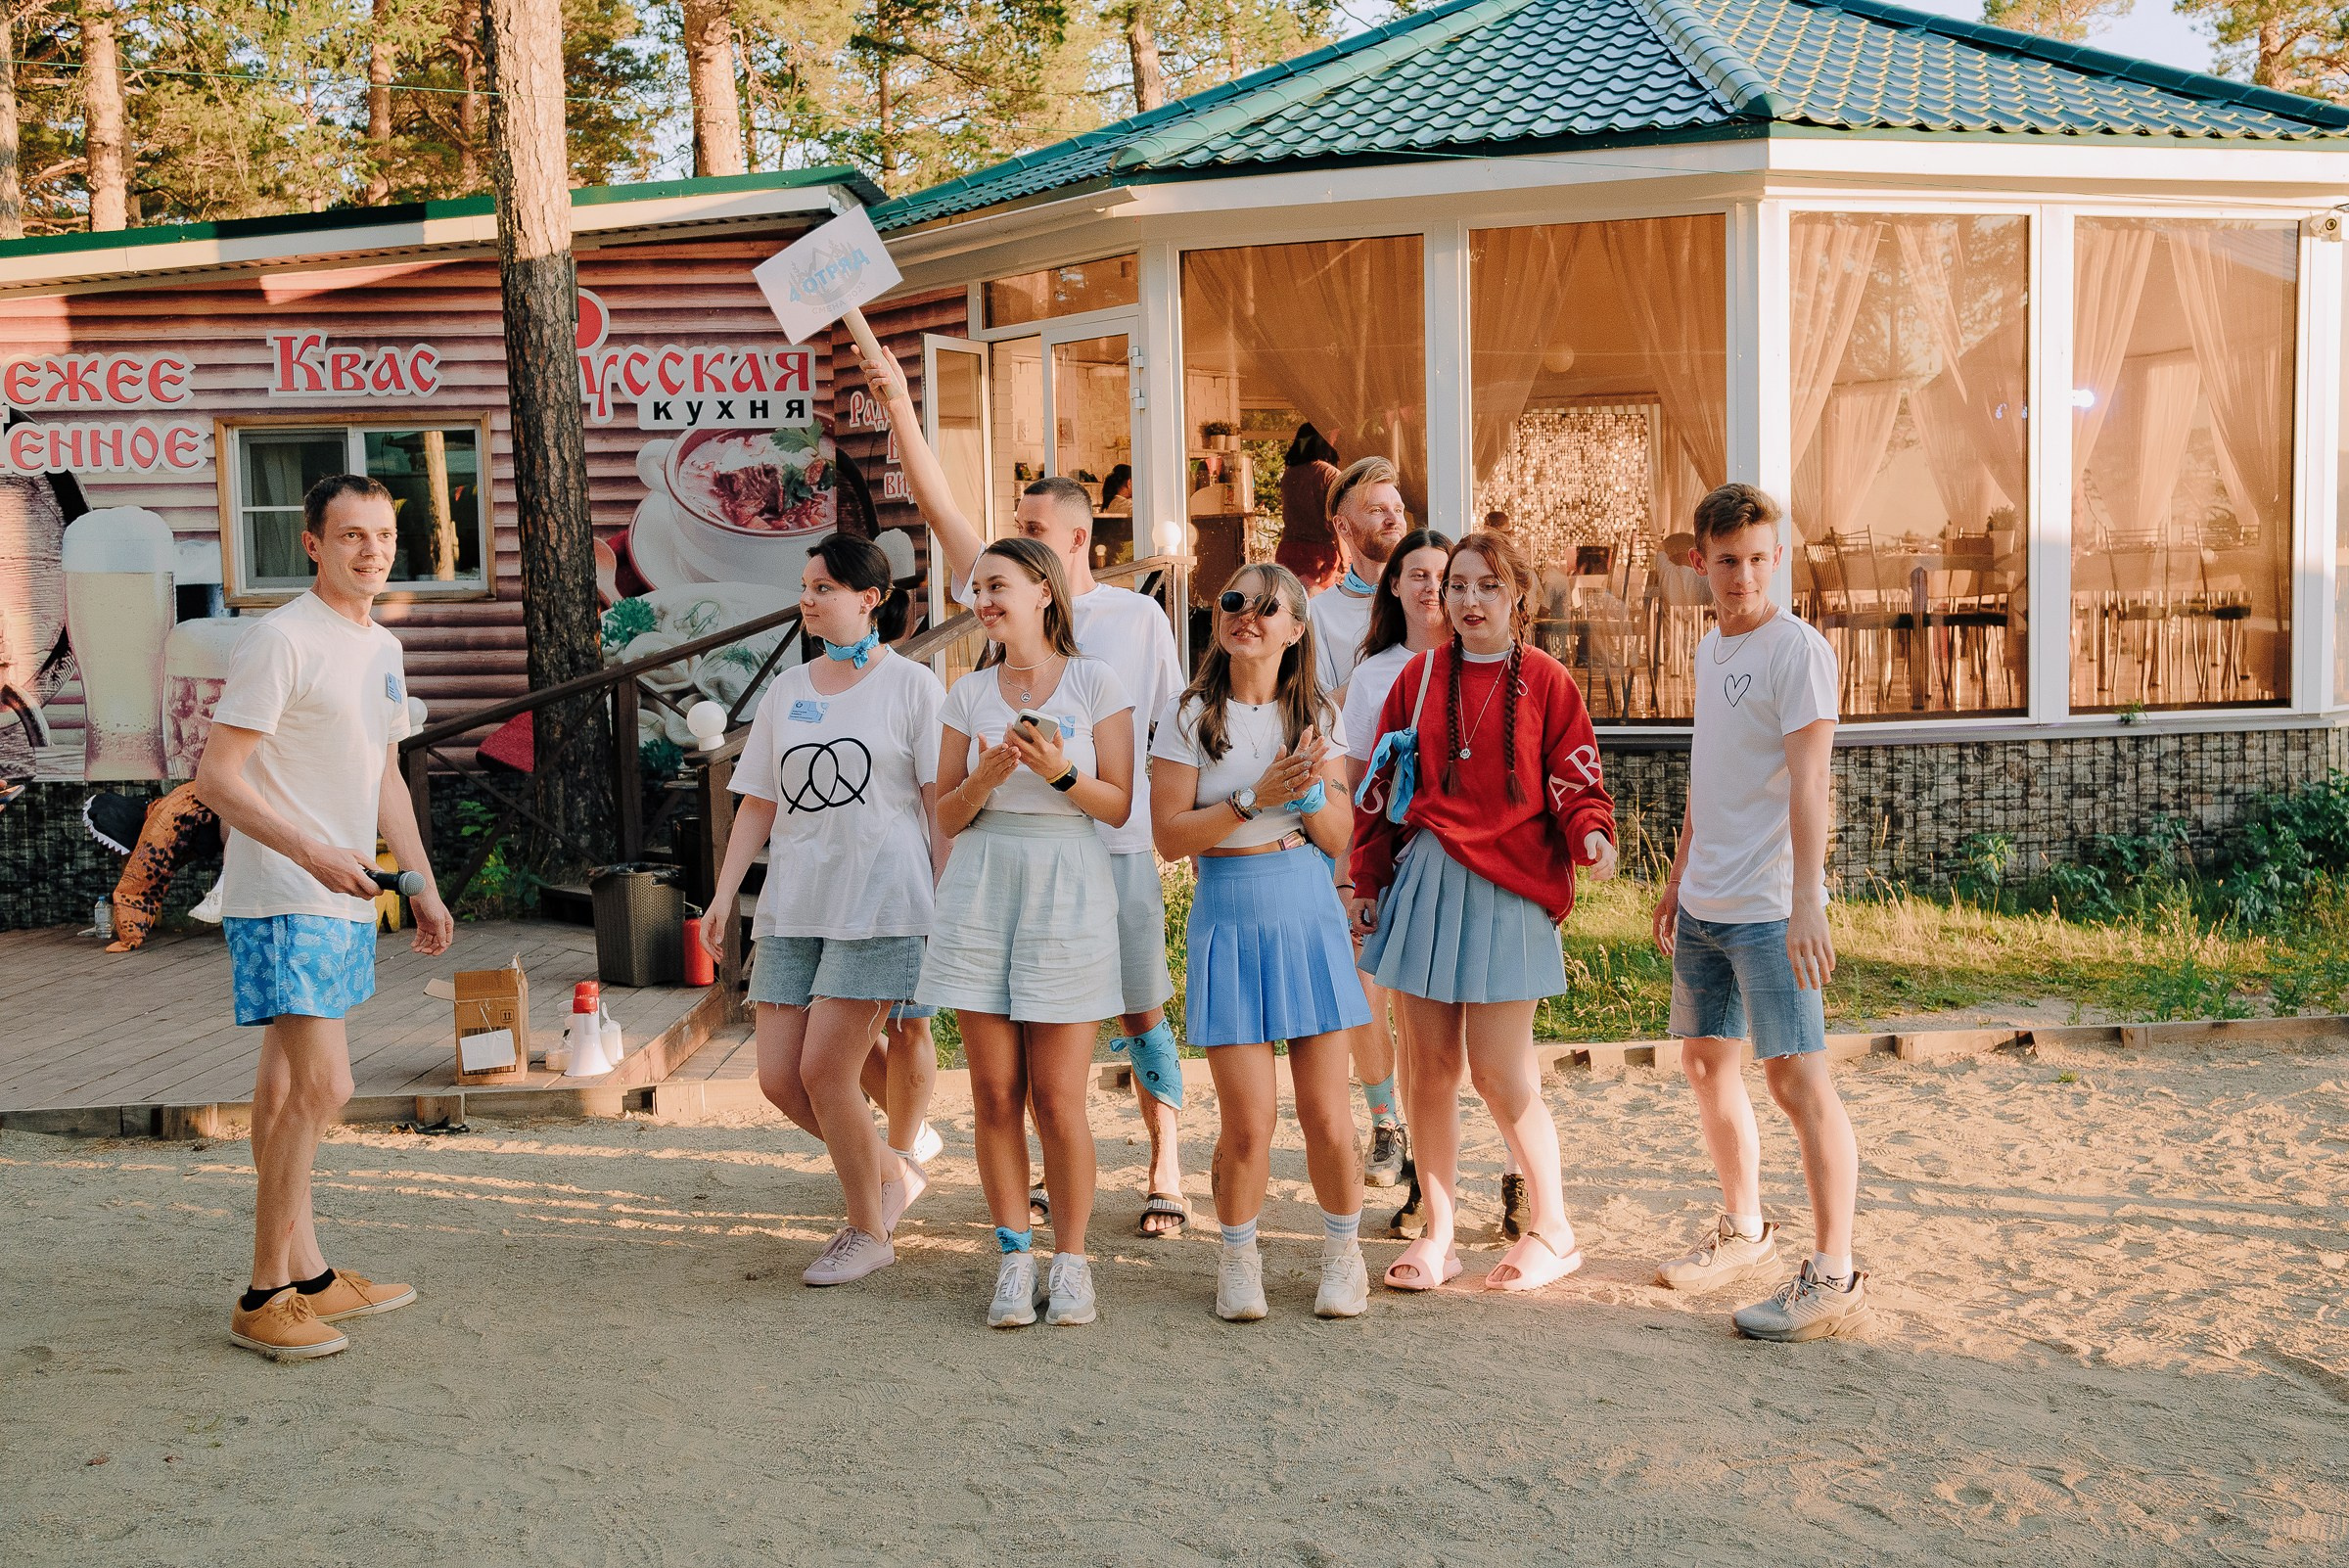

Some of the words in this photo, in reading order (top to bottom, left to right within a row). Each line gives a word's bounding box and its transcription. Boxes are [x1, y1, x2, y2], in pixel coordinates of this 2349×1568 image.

[789, 284, 802, 302] 4
[803, 248, 871, 294] ОТРЯД
[811, 300, 847, 314] СМЕНА
[848, 281, 866, 301] 2023
[272, 335, 438, 392] Квас
[653, 398, 806, 427] кухня
[851, 393, 889, 431] Рад
[1548, 744, 1602, 811] AR
